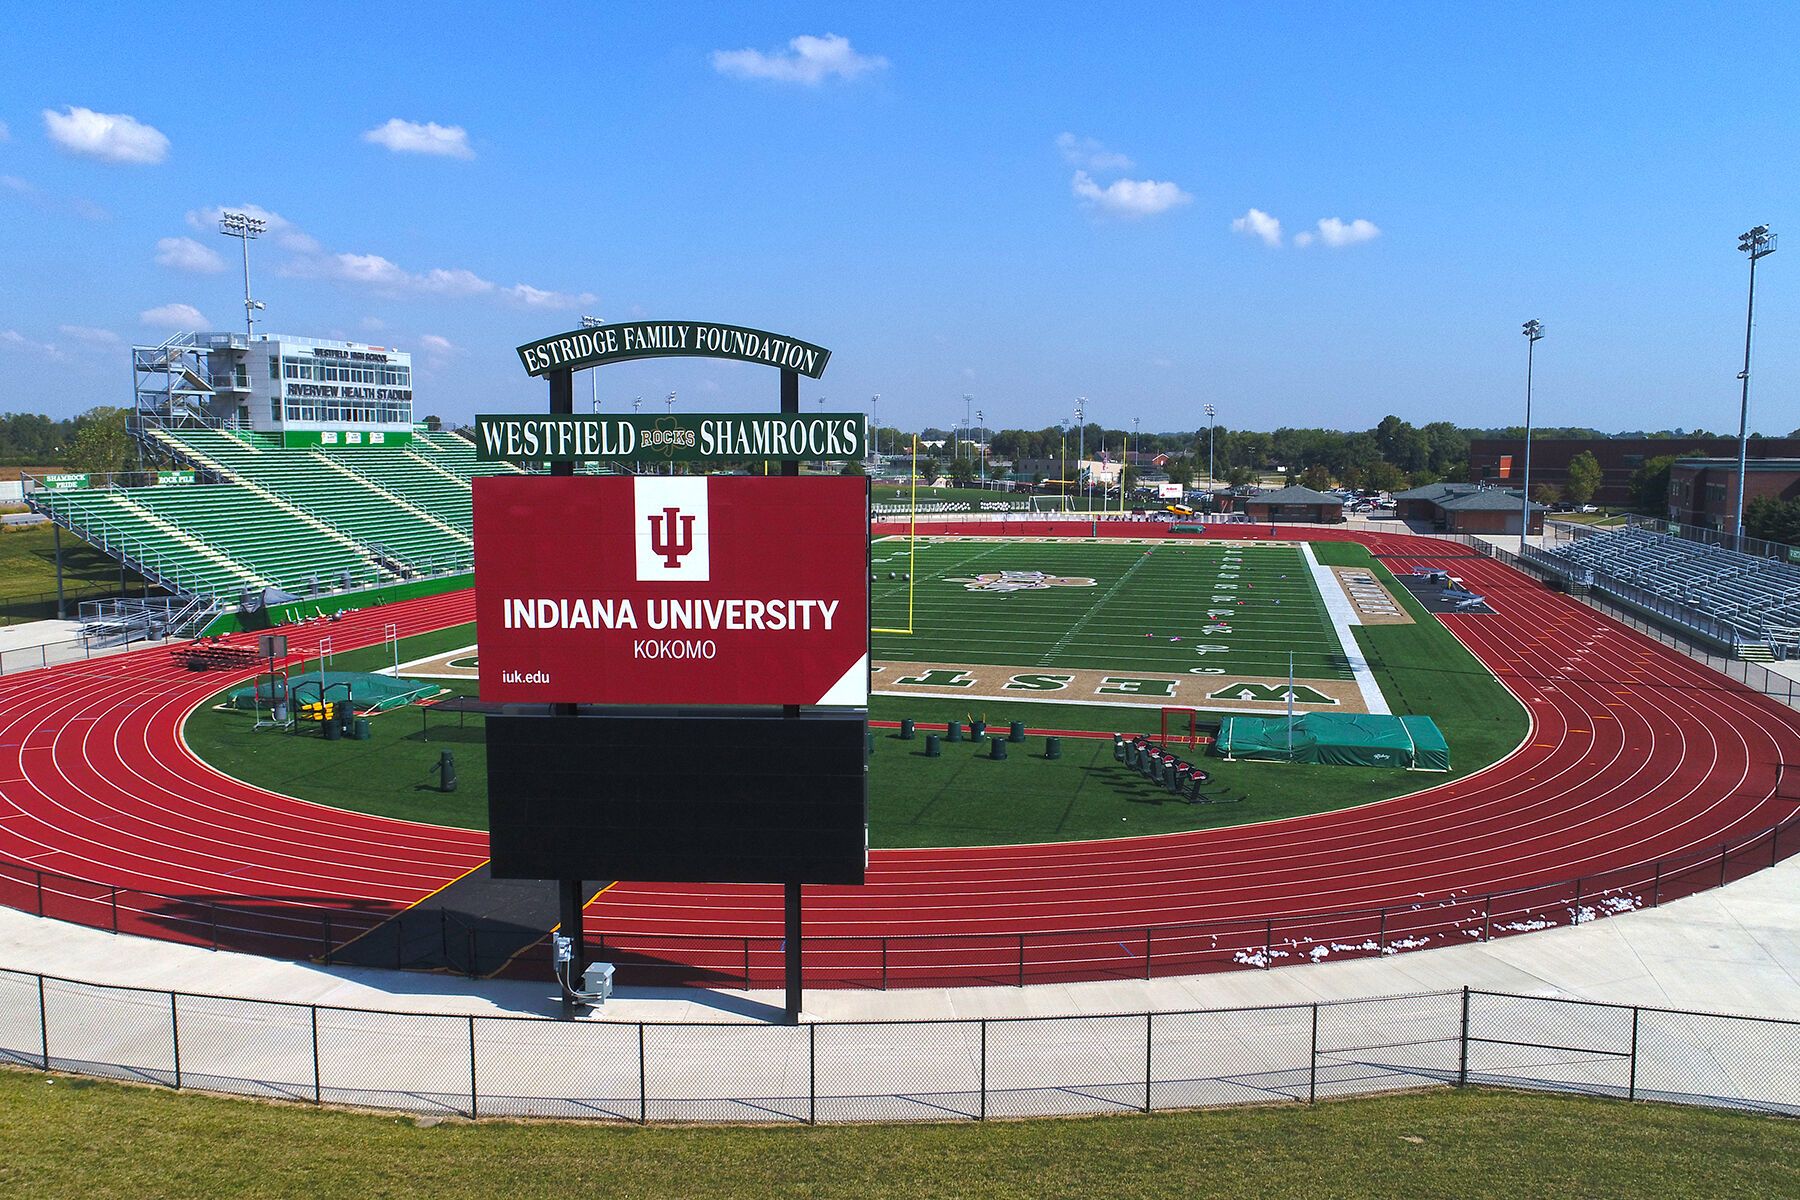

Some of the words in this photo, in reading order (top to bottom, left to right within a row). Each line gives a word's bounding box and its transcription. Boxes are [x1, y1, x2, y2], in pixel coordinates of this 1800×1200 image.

[313, 348, 349, 359] WESTFIELD
[350, 351, 364, 361] HIGH
[366, 353, 388, 363] SCHOOL
[523, 330, 618, 372] ESTRIDGE
[624, 325, 690, 350] FAMILY
[696, 327, 819, 373] FOUNDATION
[287, 383, 339, 398] RIVERVIEW
[341, 386, 375, 399] HEALTH
[377, 388, 412, 401] STADIUM
[481, 420, 636, 456] WESTFIELD
[641, 429, 696, 448] ROCKS
[700, 420, 858, 455] SHAMROCKS
[46, 474, 86, 482] SHAMROCK
[158, 476, 177, 484] ROCK
[503, 598, 638, 630] INDIANA
[647, 599, 840, 631] UNIVERSITY
[634, 639, 716, 660] KOKOMO
[502, 670, 550, 684] iuk.edu
